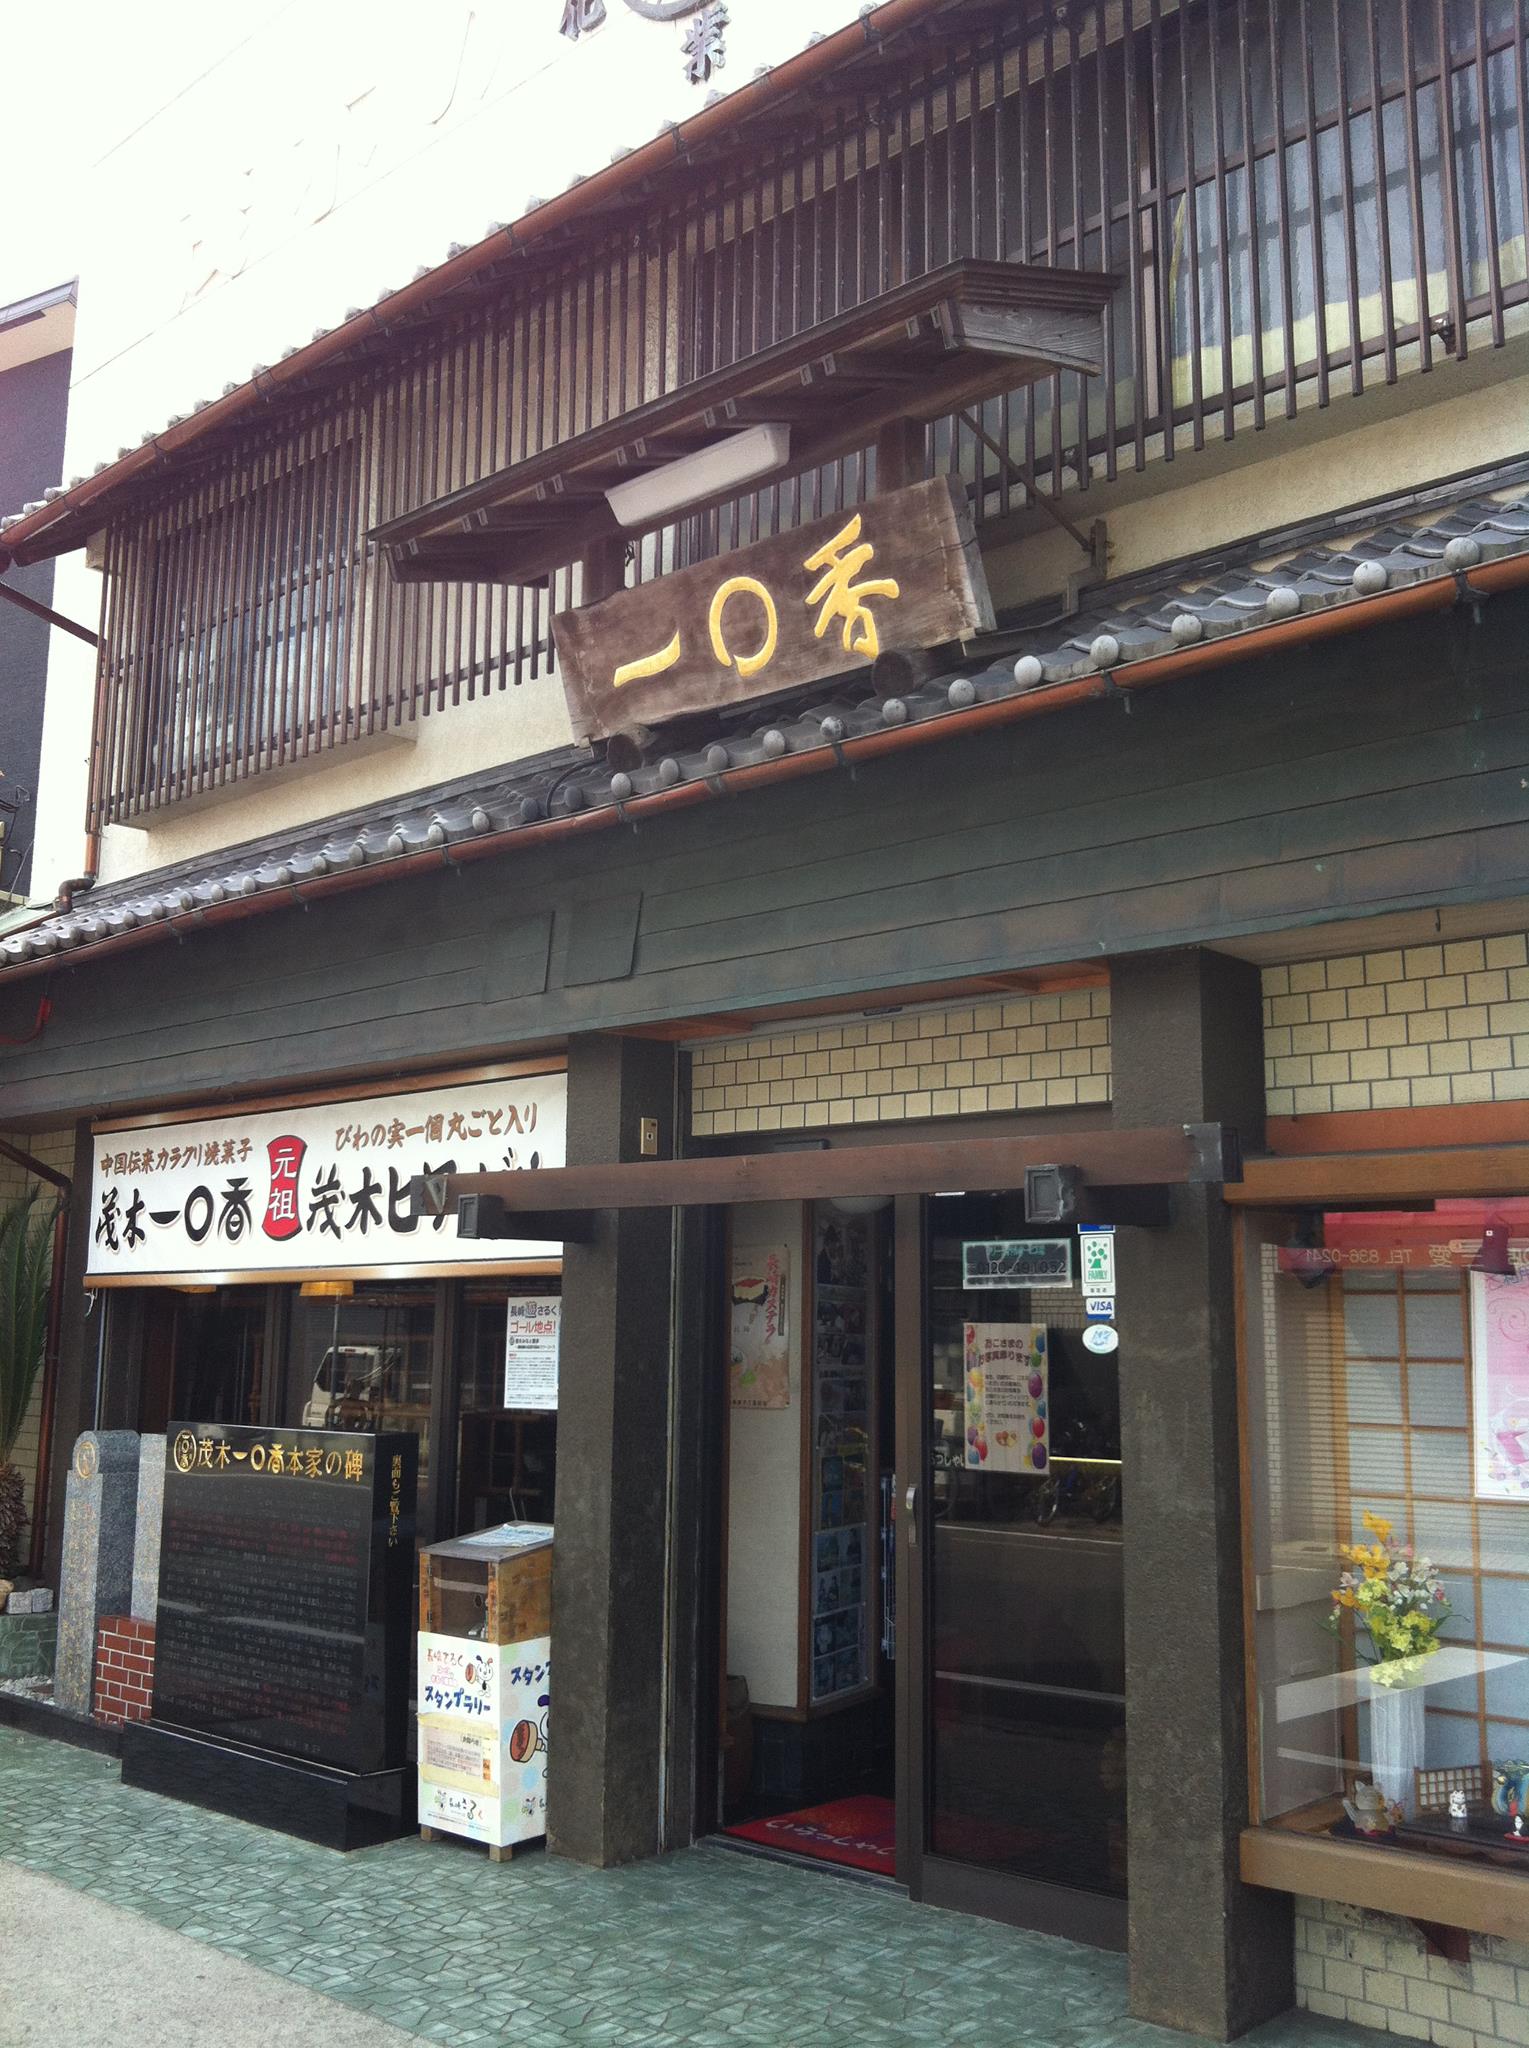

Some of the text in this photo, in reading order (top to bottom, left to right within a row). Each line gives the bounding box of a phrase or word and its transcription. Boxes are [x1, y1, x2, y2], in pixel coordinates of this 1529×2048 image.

[335, 1102, 538, 1151] びわの実一個丸ごと入り
[100, 1137, 253, 1178] 中国伝来カラクリ焼菓子
[268, 1147, 298, 1221] 元祖
[1090, 1301, 1112, 1311] VISA
[425, 1686, 491, 1715] スタンプラリー
